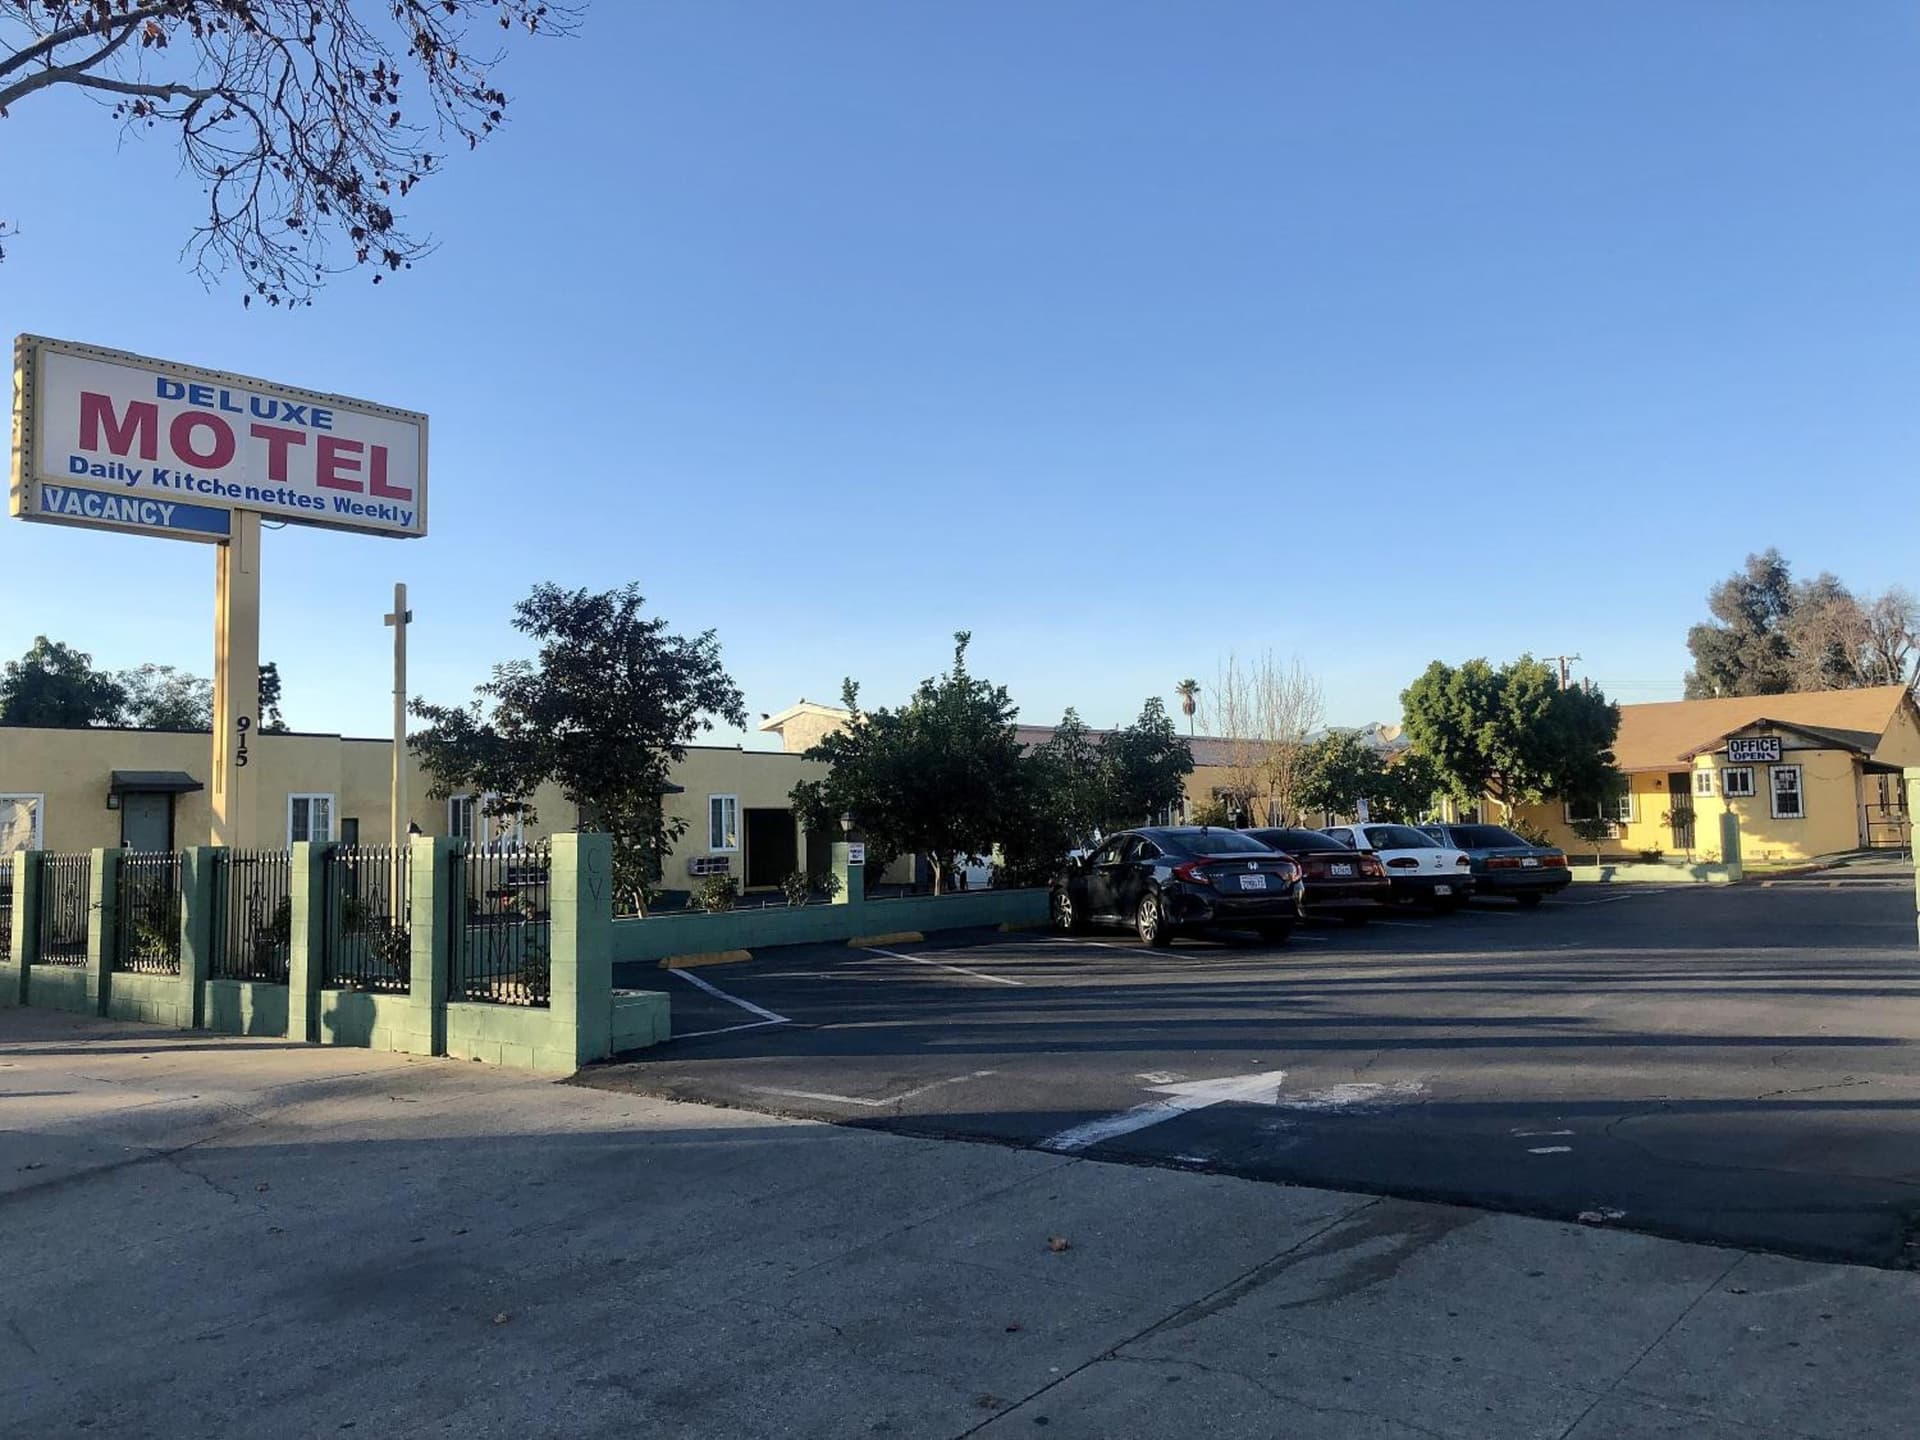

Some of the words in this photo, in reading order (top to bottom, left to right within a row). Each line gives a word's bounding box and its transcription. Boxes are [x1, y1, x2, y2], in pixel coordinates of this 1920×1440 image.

[156, 377, 334, 430] DELUXE
[79, 391, 412, 502] MOTEL
[45, 488, 176, 527] VACANCY
[69, 455, 143, 487] Daily
[152, 468, 325, 510] Kitchenettes
[333, 496, 413, 527] Weekly
[235, 716, 251, 767] 915
[1731, 739, 1778, 752] OFFICE
[1734, 752, 1765, 760] OPEN
